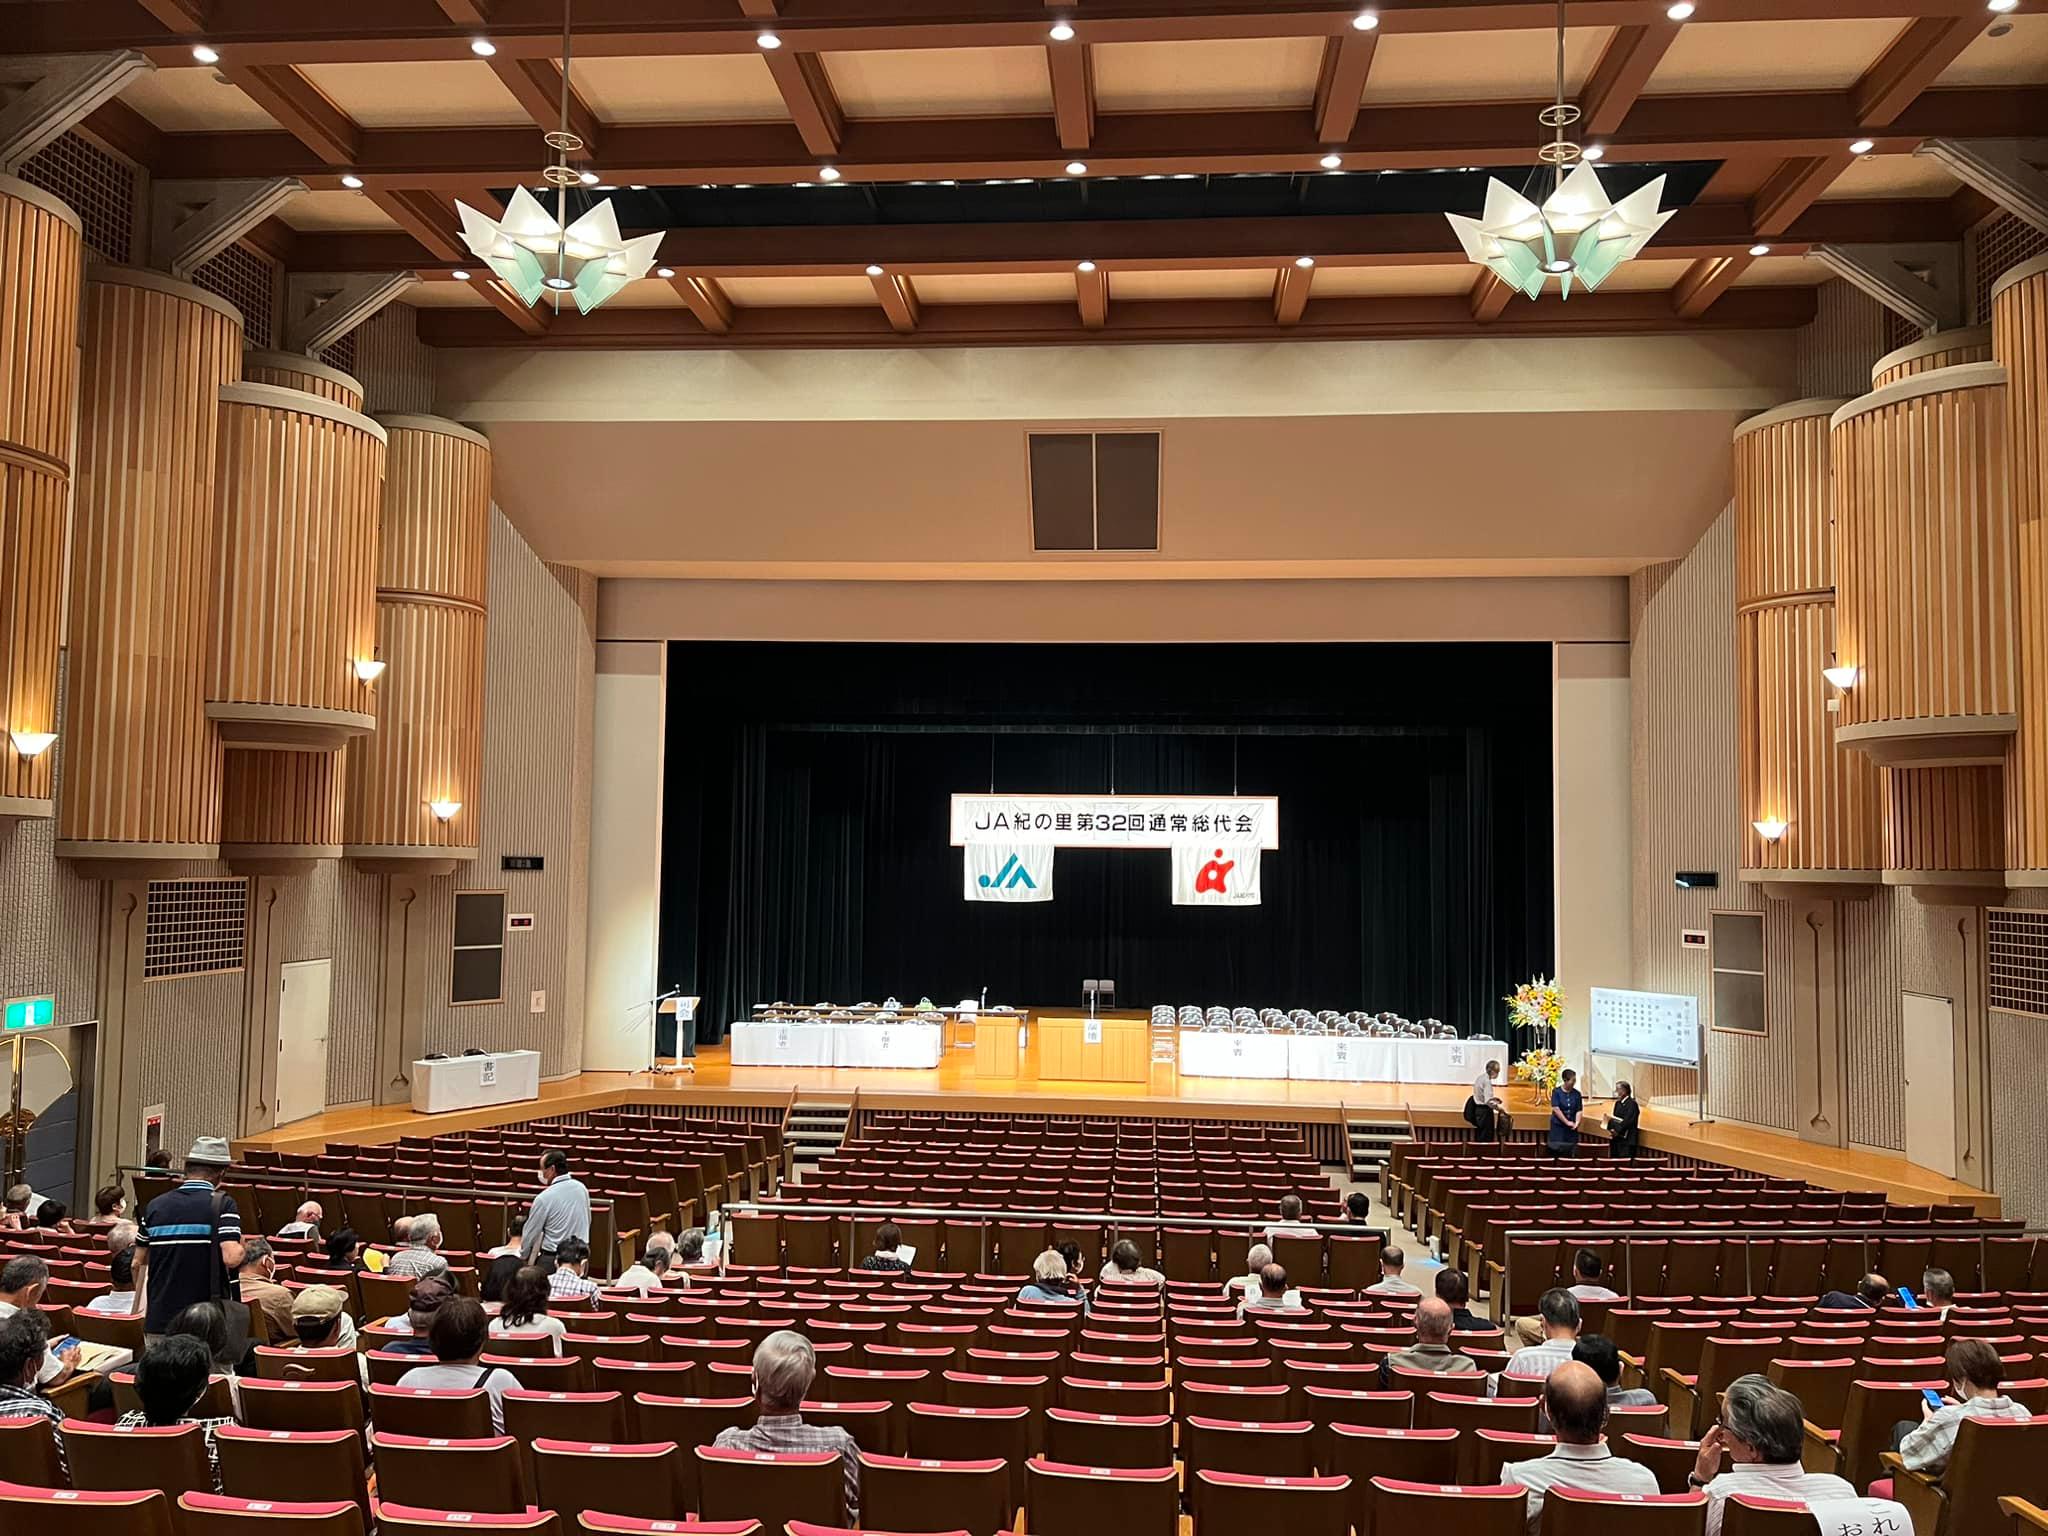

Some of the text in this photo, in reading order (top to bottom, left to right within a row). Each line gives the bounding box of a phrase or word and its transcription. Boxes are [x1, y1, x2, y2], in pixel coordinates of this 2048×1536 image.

[975, 812, 1253, 833] JA紀の里第32回通常総代会
[1866, 1503, 1901, 1536] これ
